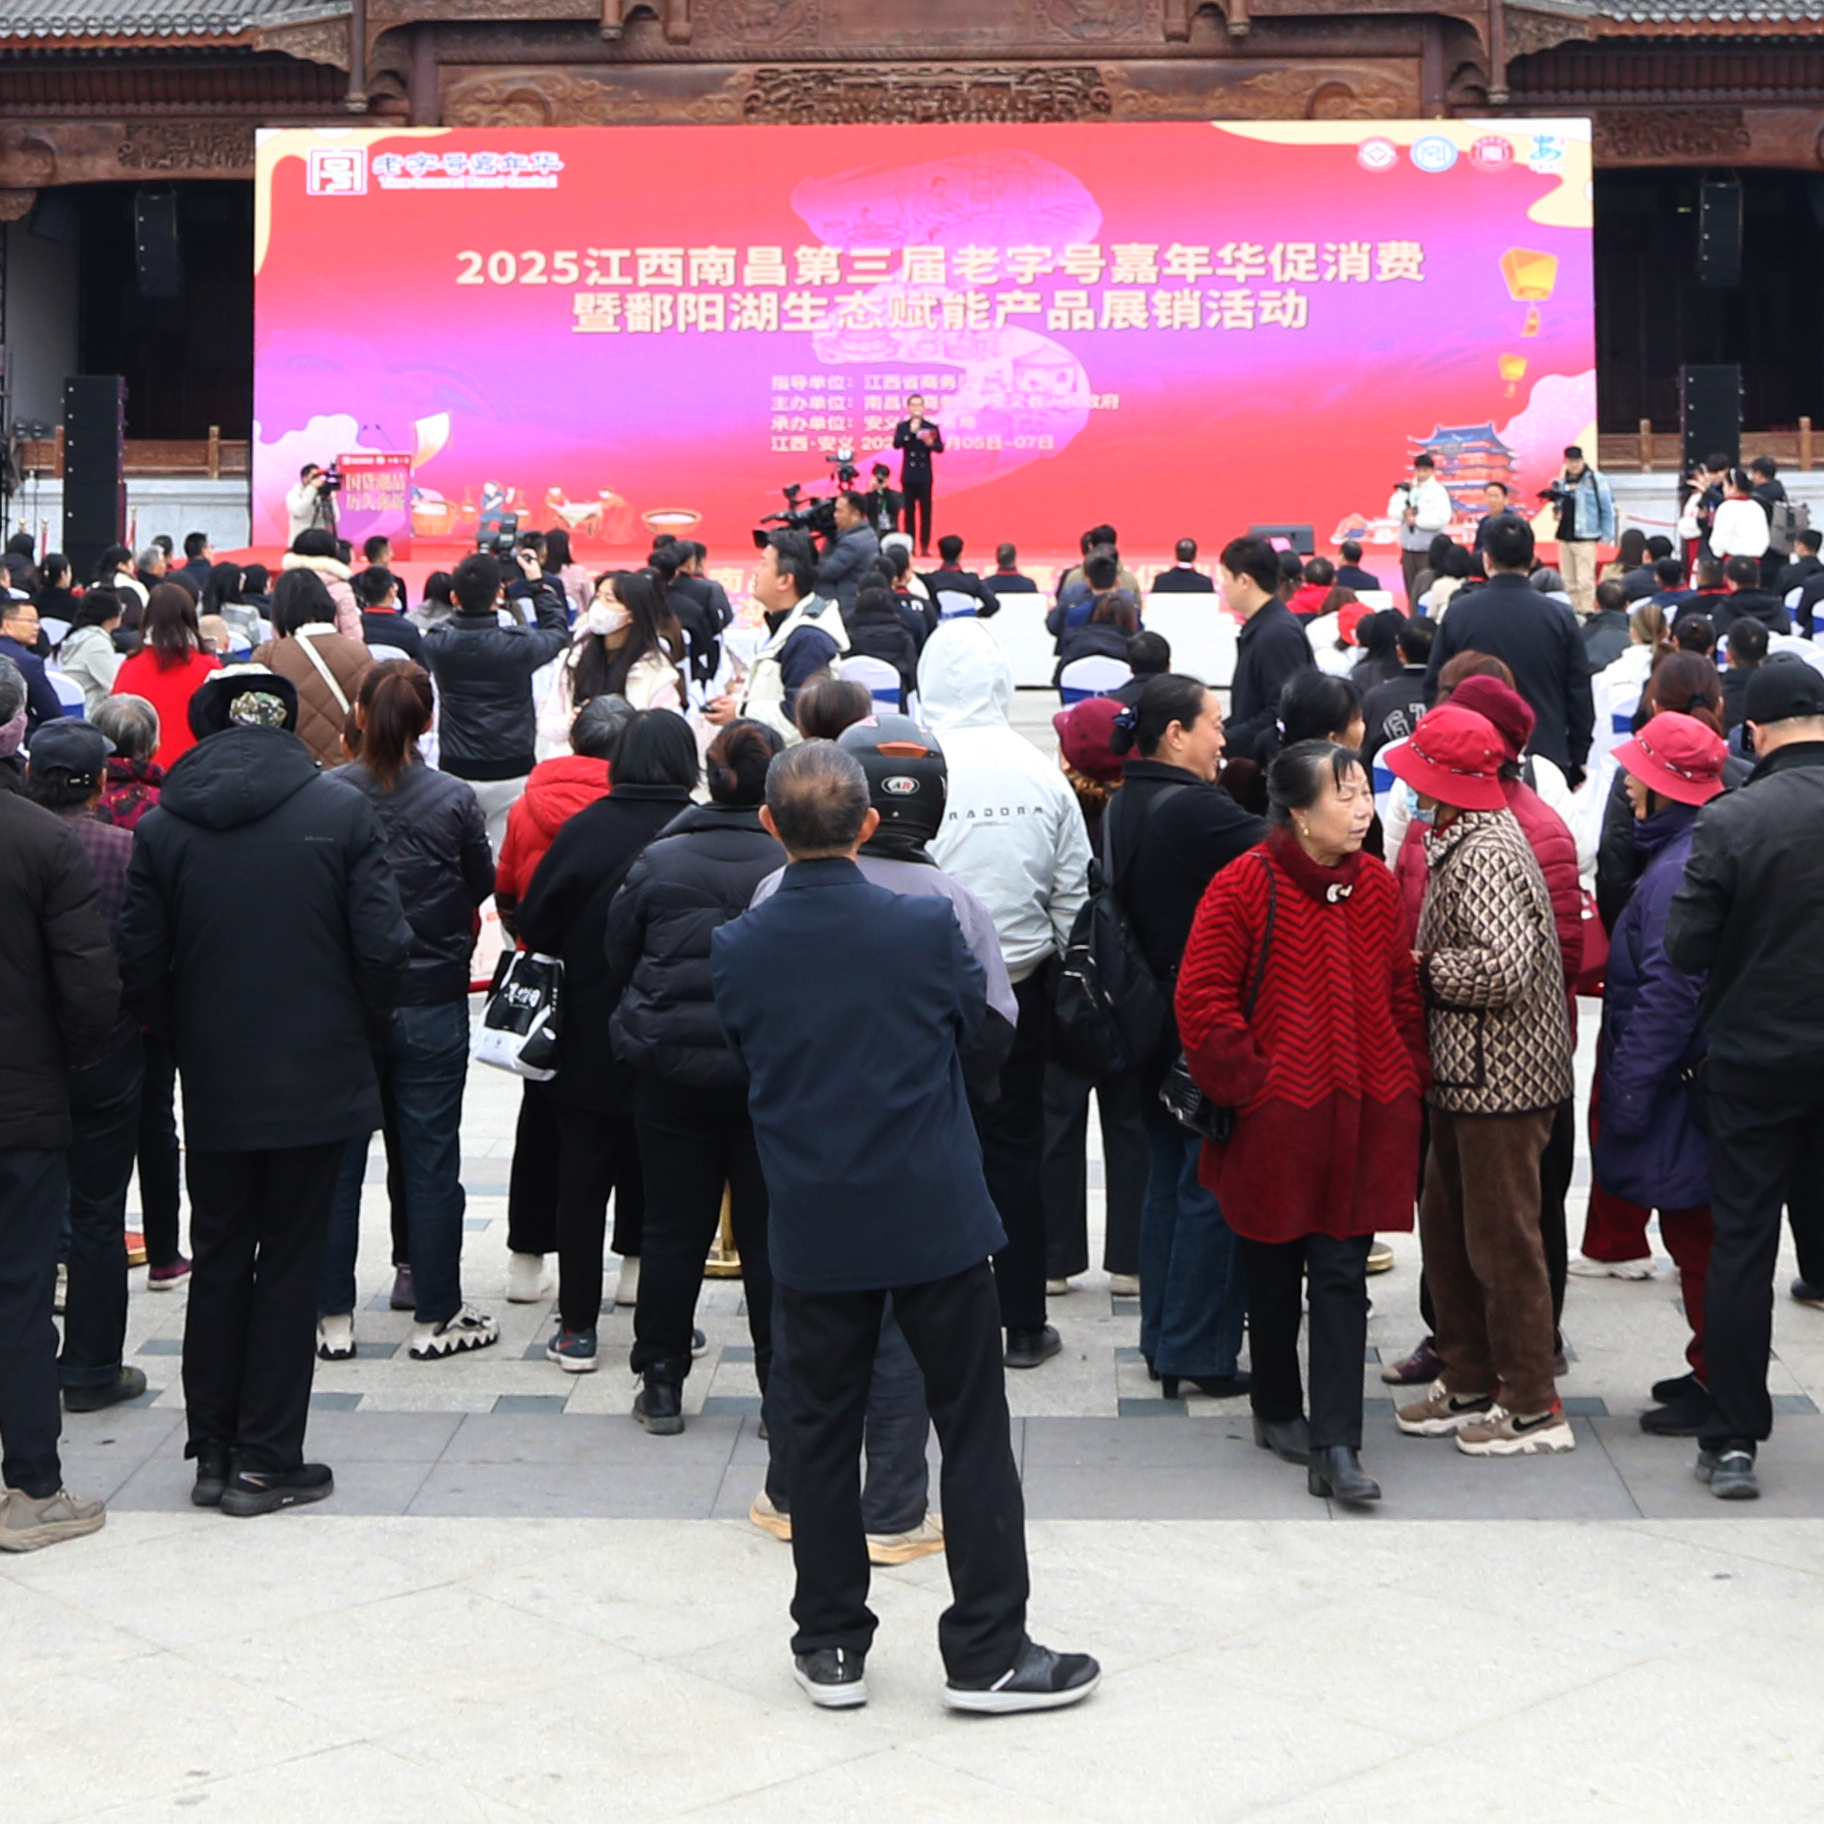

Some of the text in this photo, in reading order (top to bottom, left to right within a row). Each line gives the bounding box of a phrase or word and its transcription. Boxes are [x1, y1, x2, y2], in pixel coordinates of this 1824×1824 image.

[455, 240, 1425, 287] 2025江西南昌第三届老字号嘉年华促消费
[571, 288, 1309, 334] 暨鄱阳湖生态赋能产品展销活动
